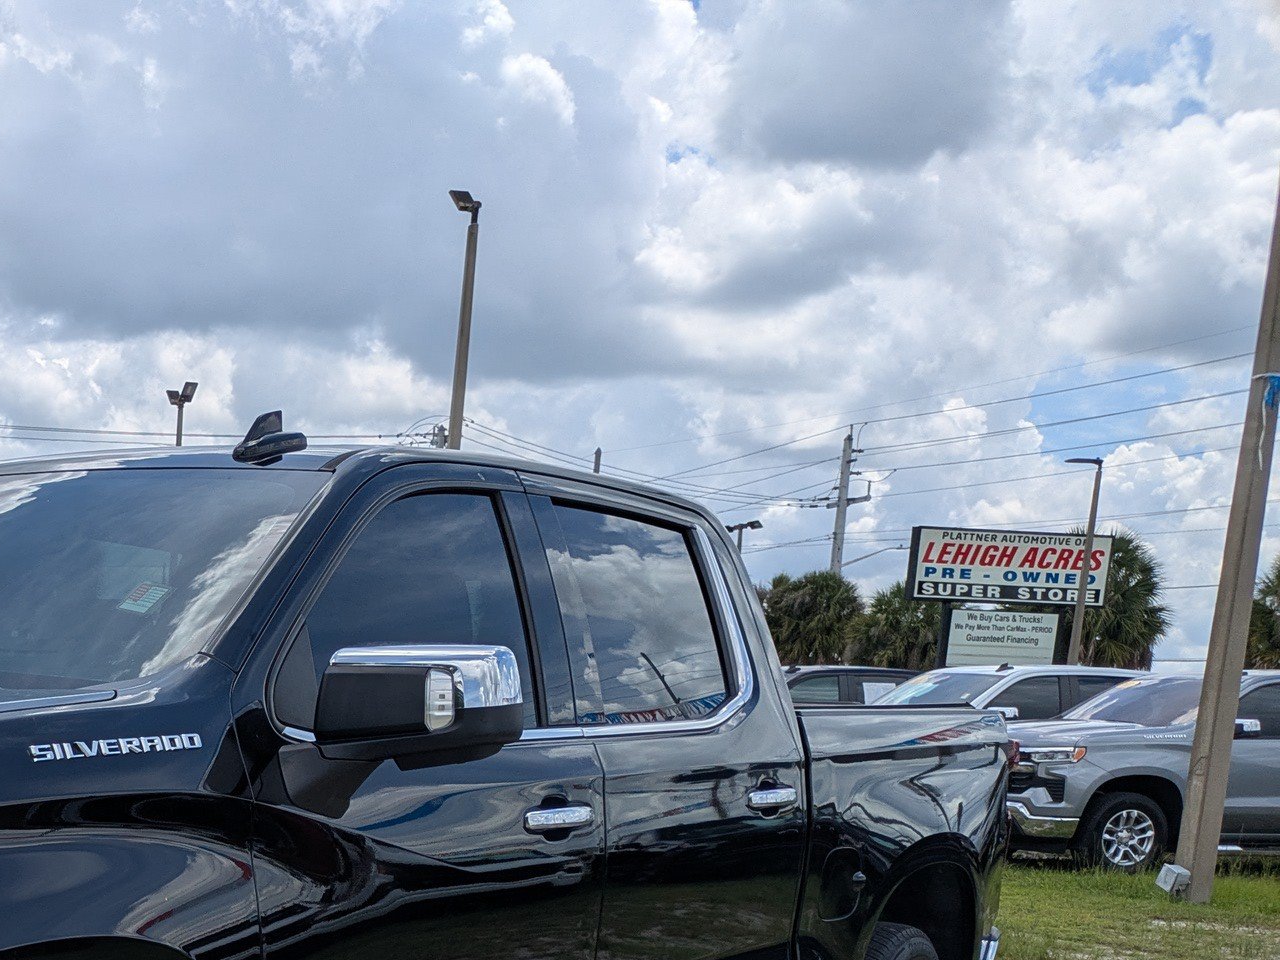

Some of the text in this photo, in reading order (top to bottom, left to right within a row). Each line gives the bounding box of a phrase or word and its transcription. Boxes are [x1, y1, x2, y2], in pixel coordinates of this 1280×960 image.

[942, 531, 998, 542] PLATTNER
[1001, 534, 1071, 546] AUTOMOTIVE
[921, 541, 1106, 572] LEHIGH ACRES
[924, 566, 972, 580] PRE
[1002, 570, 1096, 586] OWNED
[921, 582, 1096, 603] SUPER STORE
[967, 612, 1043, 624] We Buy Cars & Trucks!
[965, 623, 975, 632] Pay
[992, 624, 1005, 632] Than
[1031, 626, 1053, 634] PERIOD
[966, 633, 1039, 646] Guaranteed Financing
[29, 732, 203, 763] SILVERADO
